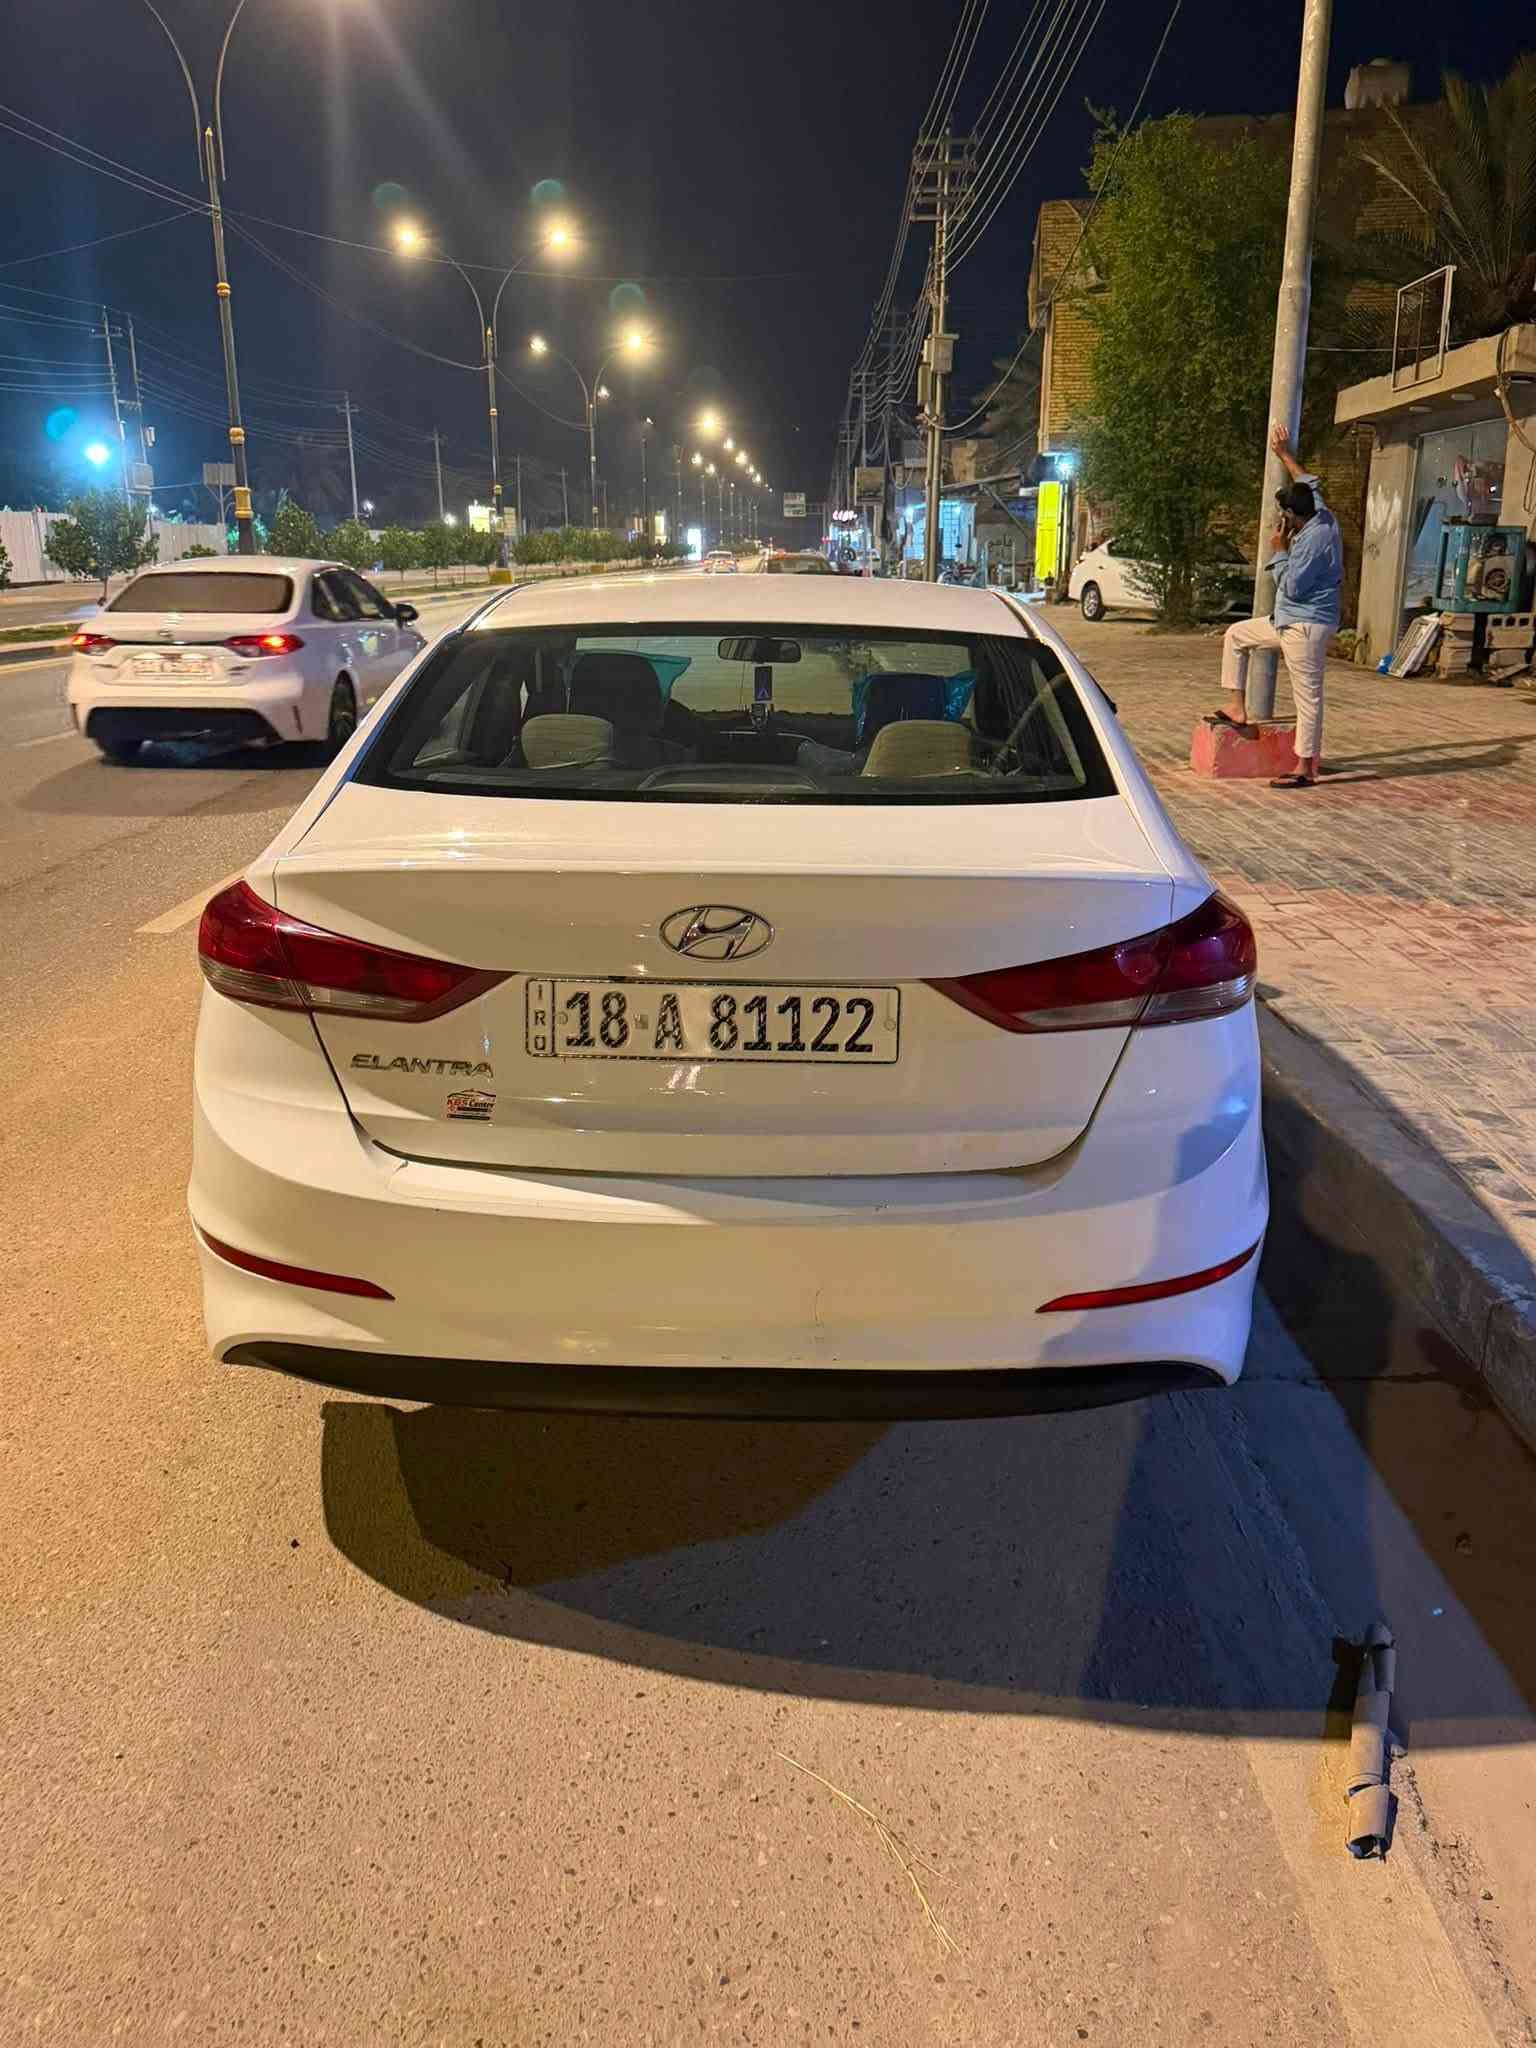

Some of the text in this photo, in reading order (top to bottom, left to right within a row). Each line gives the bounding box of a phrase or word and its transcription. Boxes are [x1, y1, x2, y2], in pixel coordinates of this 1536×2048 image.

[566, 991, 875, 1053] 18 A 81122
[348, 1054, 495, 1078] ELANTRA
